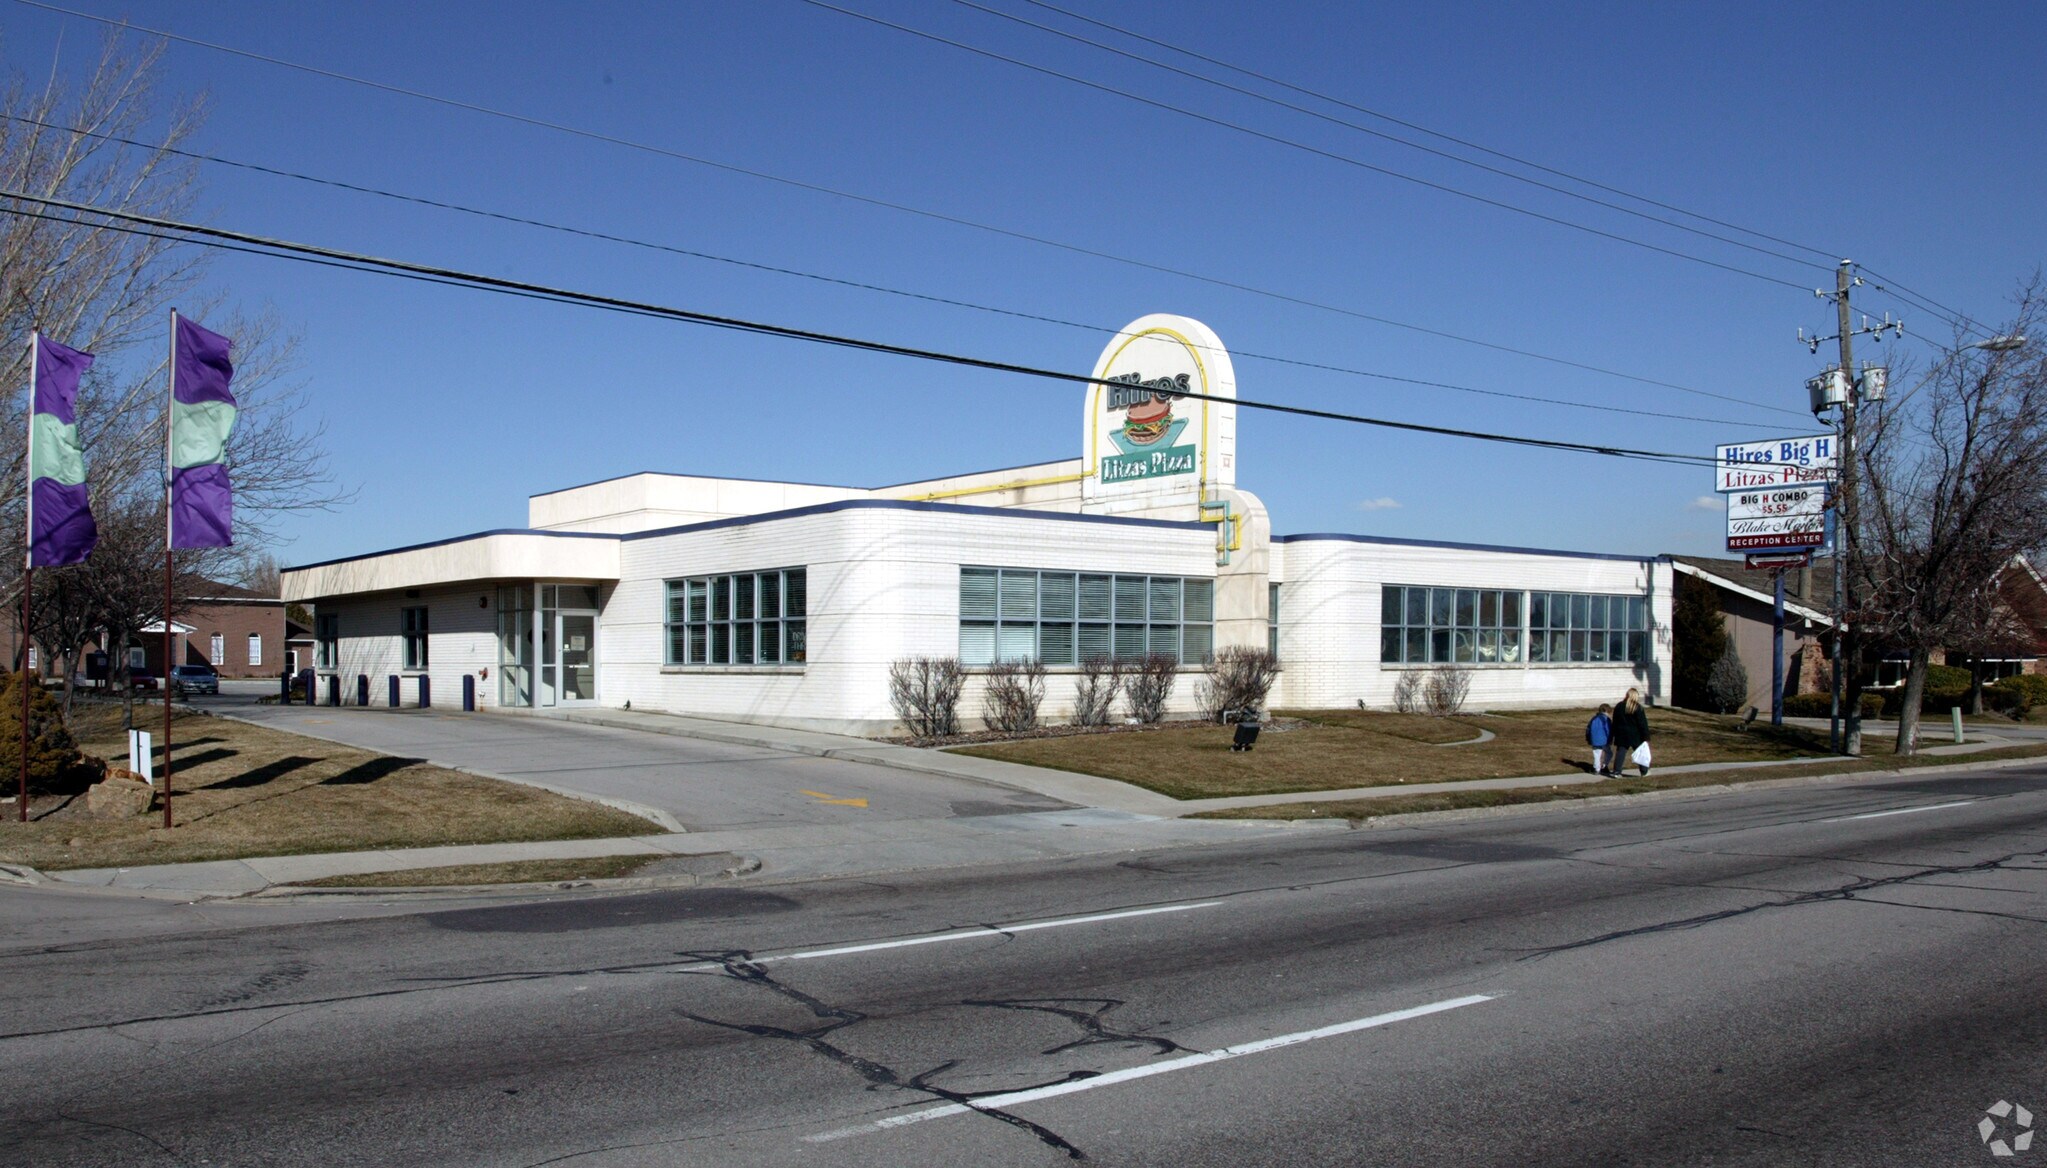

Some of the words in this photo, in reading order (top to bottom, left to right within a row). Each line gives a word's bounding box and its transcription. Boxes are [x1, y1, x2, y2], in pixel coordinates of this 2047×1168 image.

[1725, 447, 1773, 465] Hires
[1780, 442, 1810, 466] Big
[1815, 439, 1829, 458] H
[1104, 460, 1147, 479] Litzas
[1151, 452, 1192, 473] Pizza
[1725, 472, 1774, 487] Litzas
[1741, 495, 1759, 505] BIG
[1762, 494, 1769, 504] H
[1772, 491, 1808, 503] COMBO
[1730, 521, 1771, 534] Blake
[1730, 538, 1780, 546] RECEPTION
